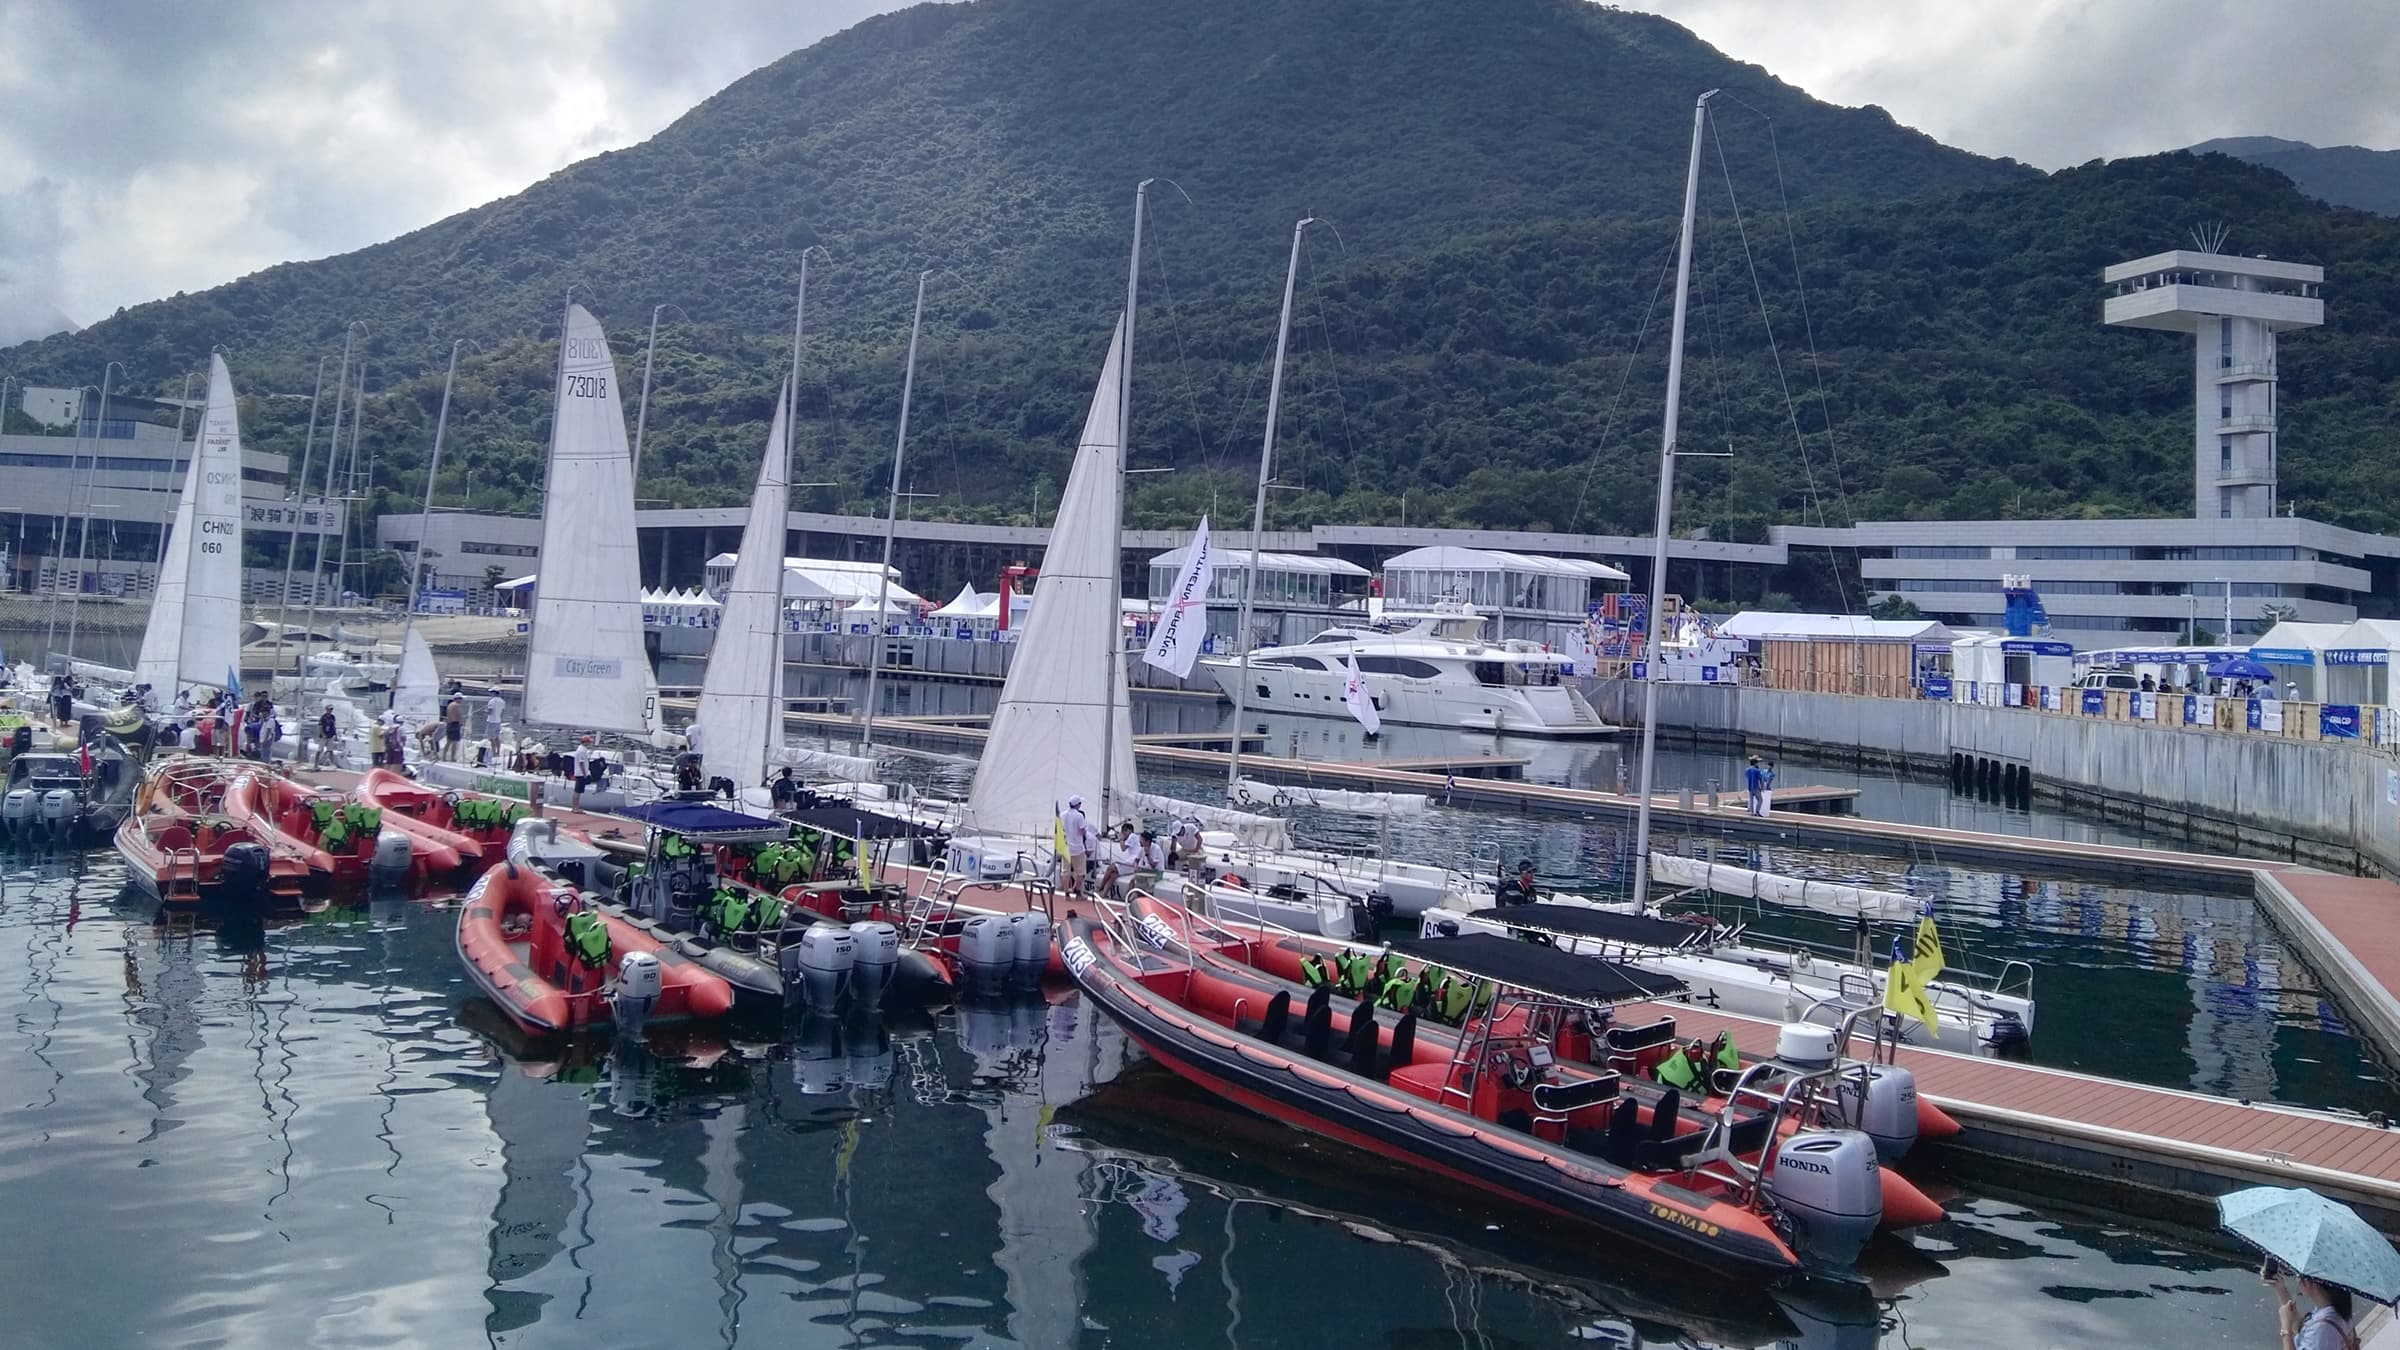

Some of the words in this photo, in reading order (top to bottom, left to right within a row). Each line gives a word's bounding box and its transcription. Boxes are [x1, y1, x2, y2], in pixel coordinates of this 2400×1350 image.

[567, 375, 607, 398] 73018
[202, 520, 234, 536] CHN20
[201, 542, 222, 554] 060
[835, 945, 853, 954] 150
[880, 939, 897, 948] 150
[1063, 939, 1094, 974] 203
[1779, 1156, 1832, 1176] HONDA
[1648, 1202, 1719, 1237] TORNADO
